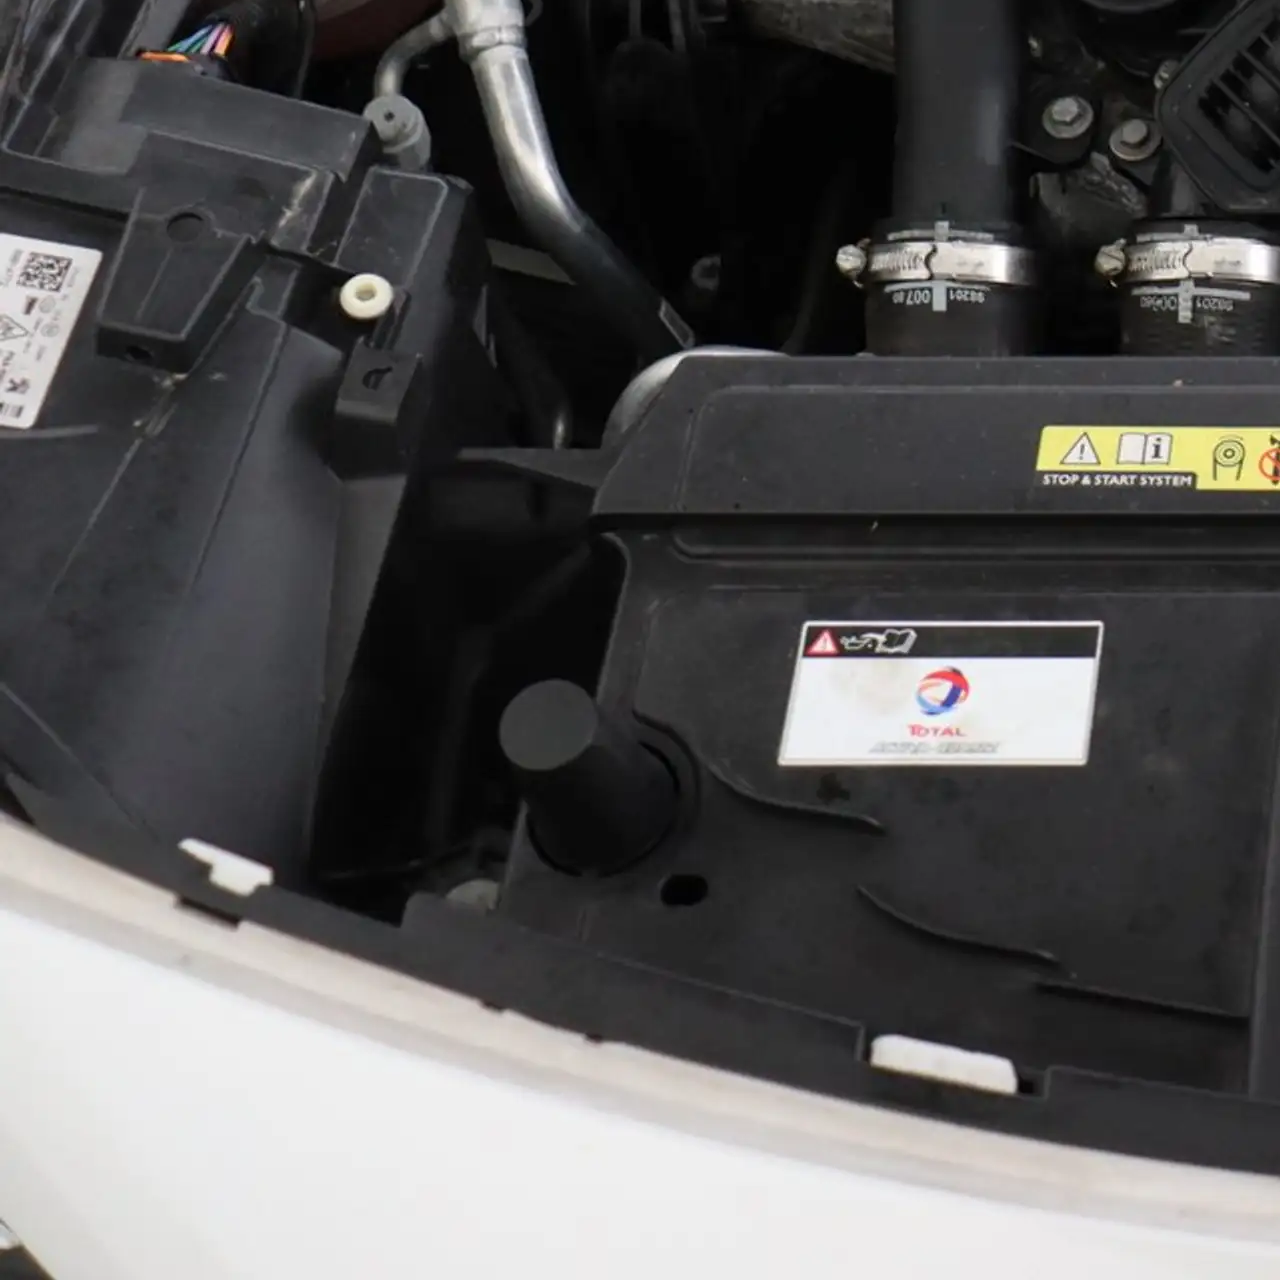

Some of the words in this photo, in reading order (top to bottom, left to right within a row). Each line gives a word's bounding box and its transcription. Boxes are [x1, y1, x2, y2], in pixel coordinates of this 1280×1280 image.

[1043, 474, 1079, 486] STOP
[1082, 474, 1091, 486] &
[1094, 474, 1136, 486] START
[1140, 474, 1193, 487] SYSTEM
[908, 723, 967, 737] TOTAL
